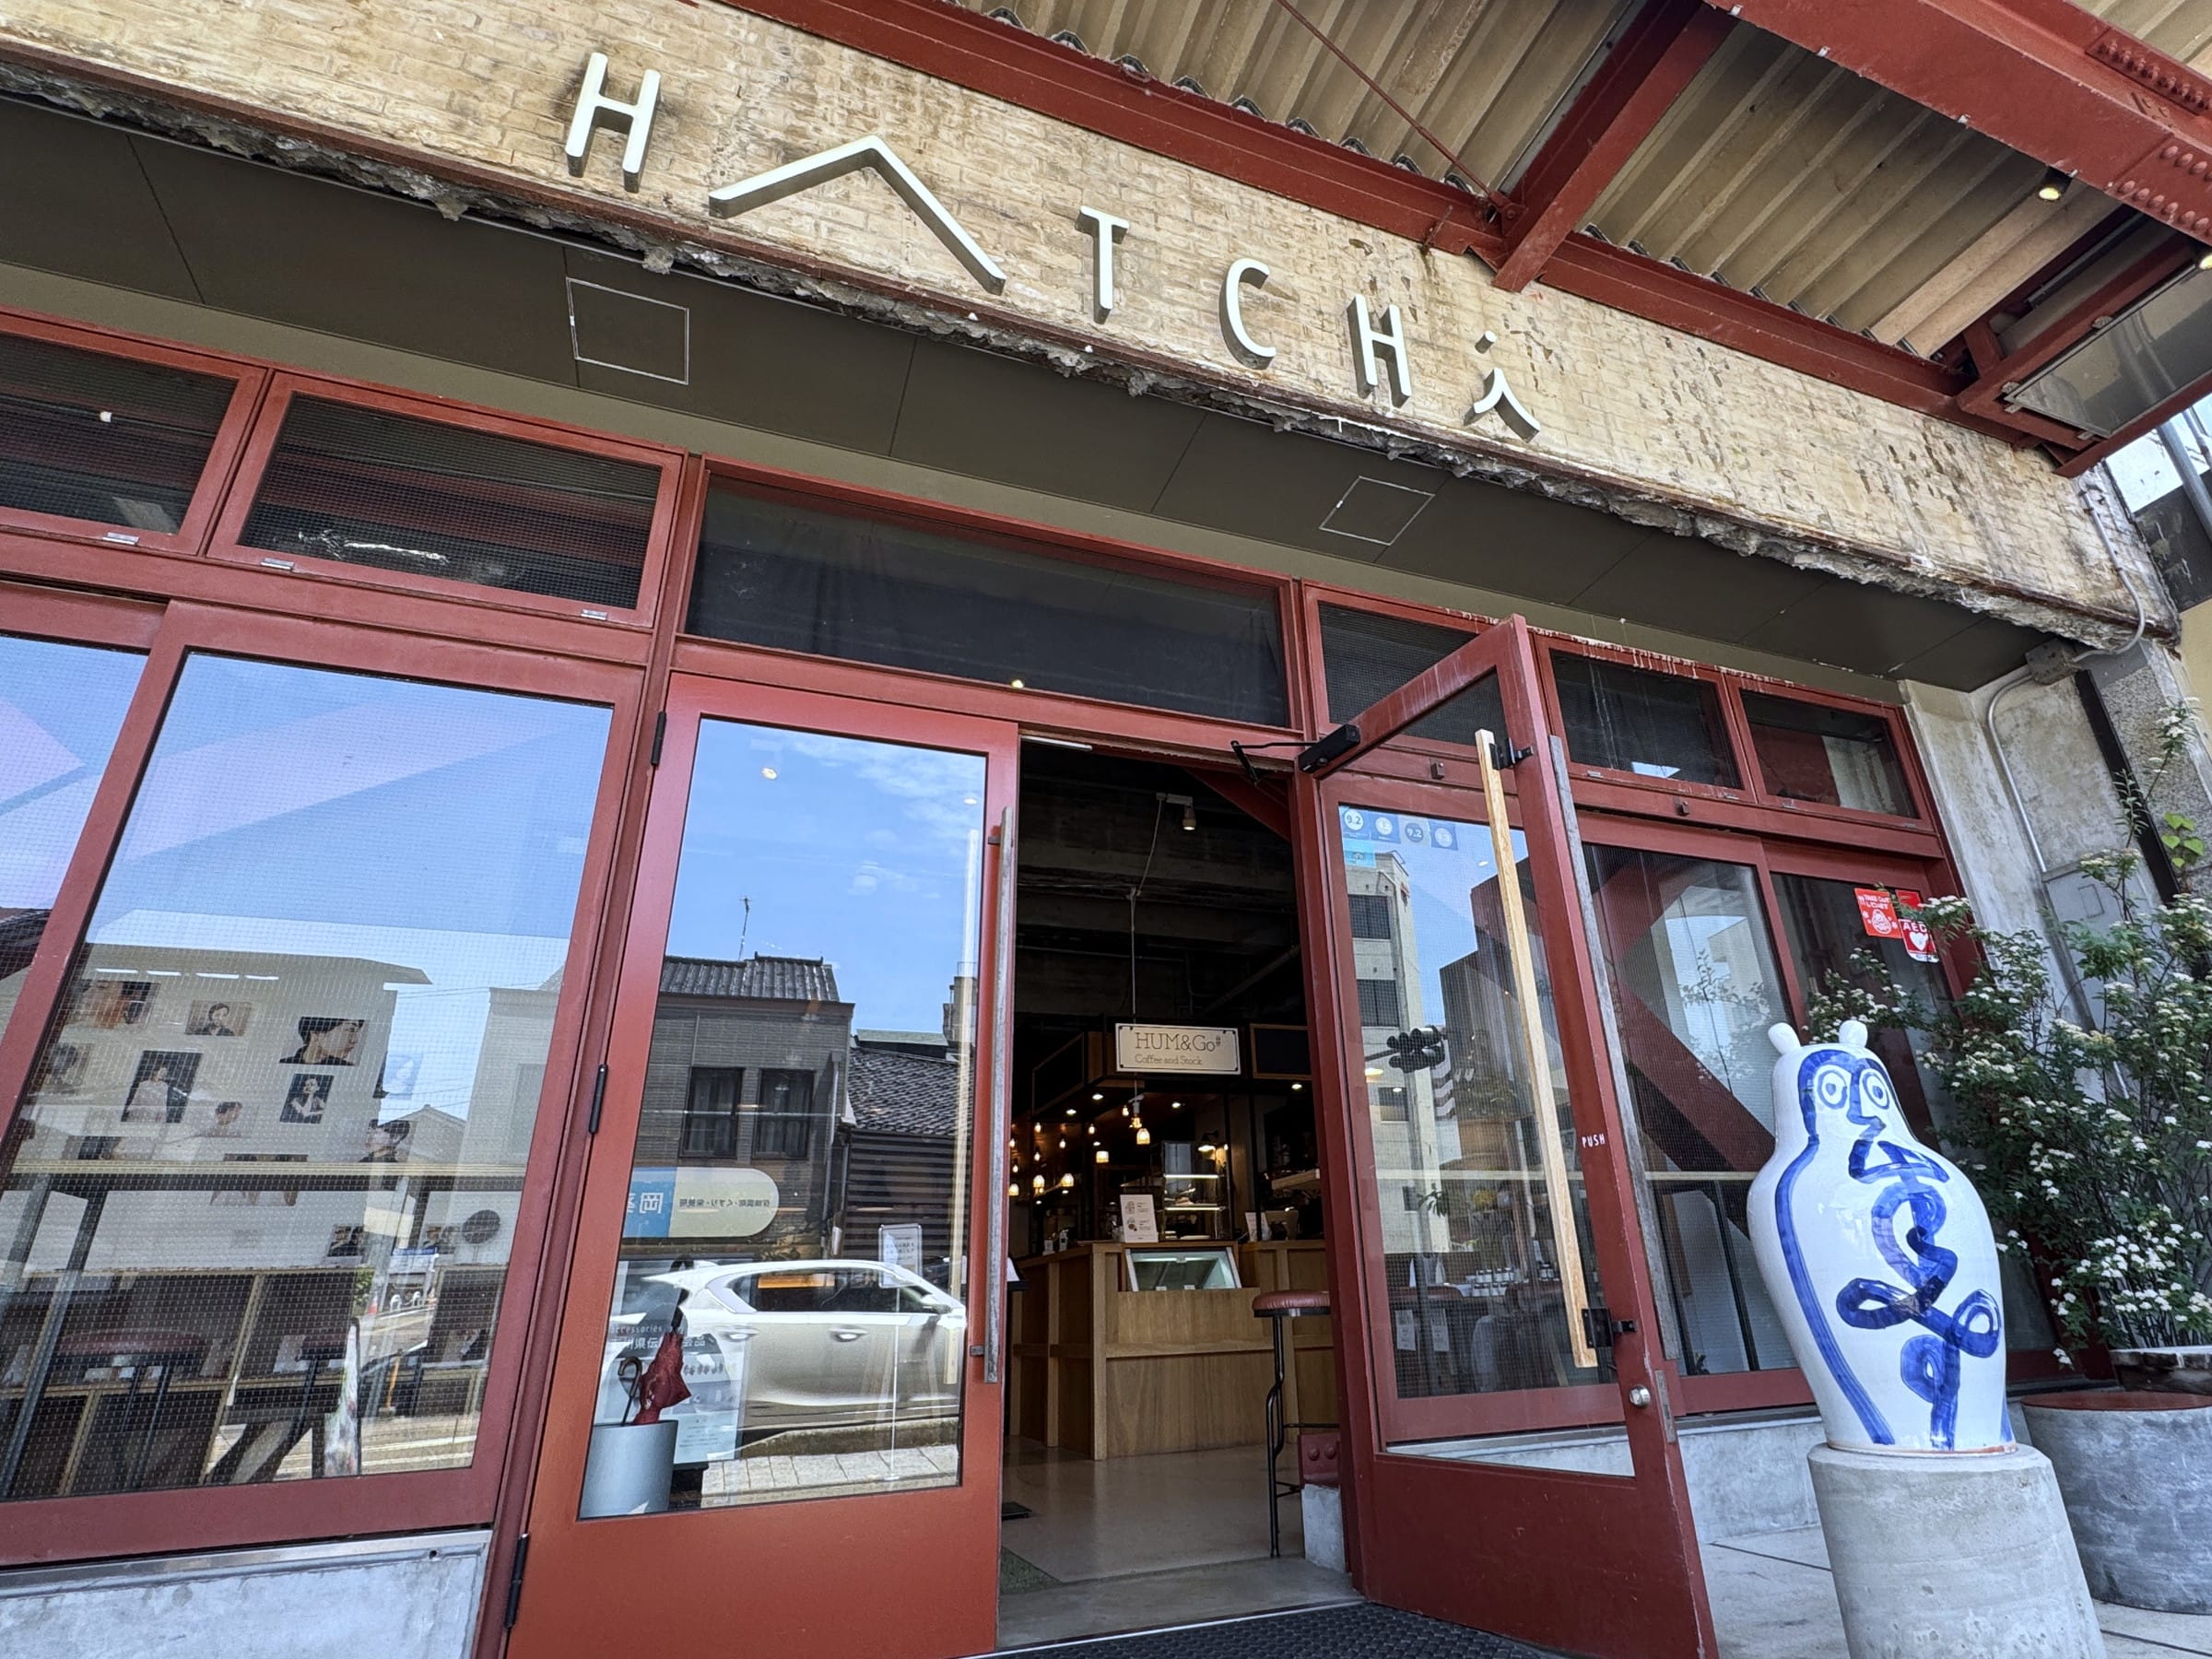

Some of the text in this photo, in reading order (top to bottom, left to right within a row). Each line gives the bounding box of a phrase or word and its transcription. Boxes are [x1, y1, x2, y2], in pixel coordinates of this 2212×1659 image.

[1406, 827, 1422, 839] 9.2
[1902, 921, 1928, 933] AED
[1135, 1053, 1162, 1065] Coffee
[1163, 1055, 1179, 1065] and
[1581, 1133, 1606, 1148] PUSH
